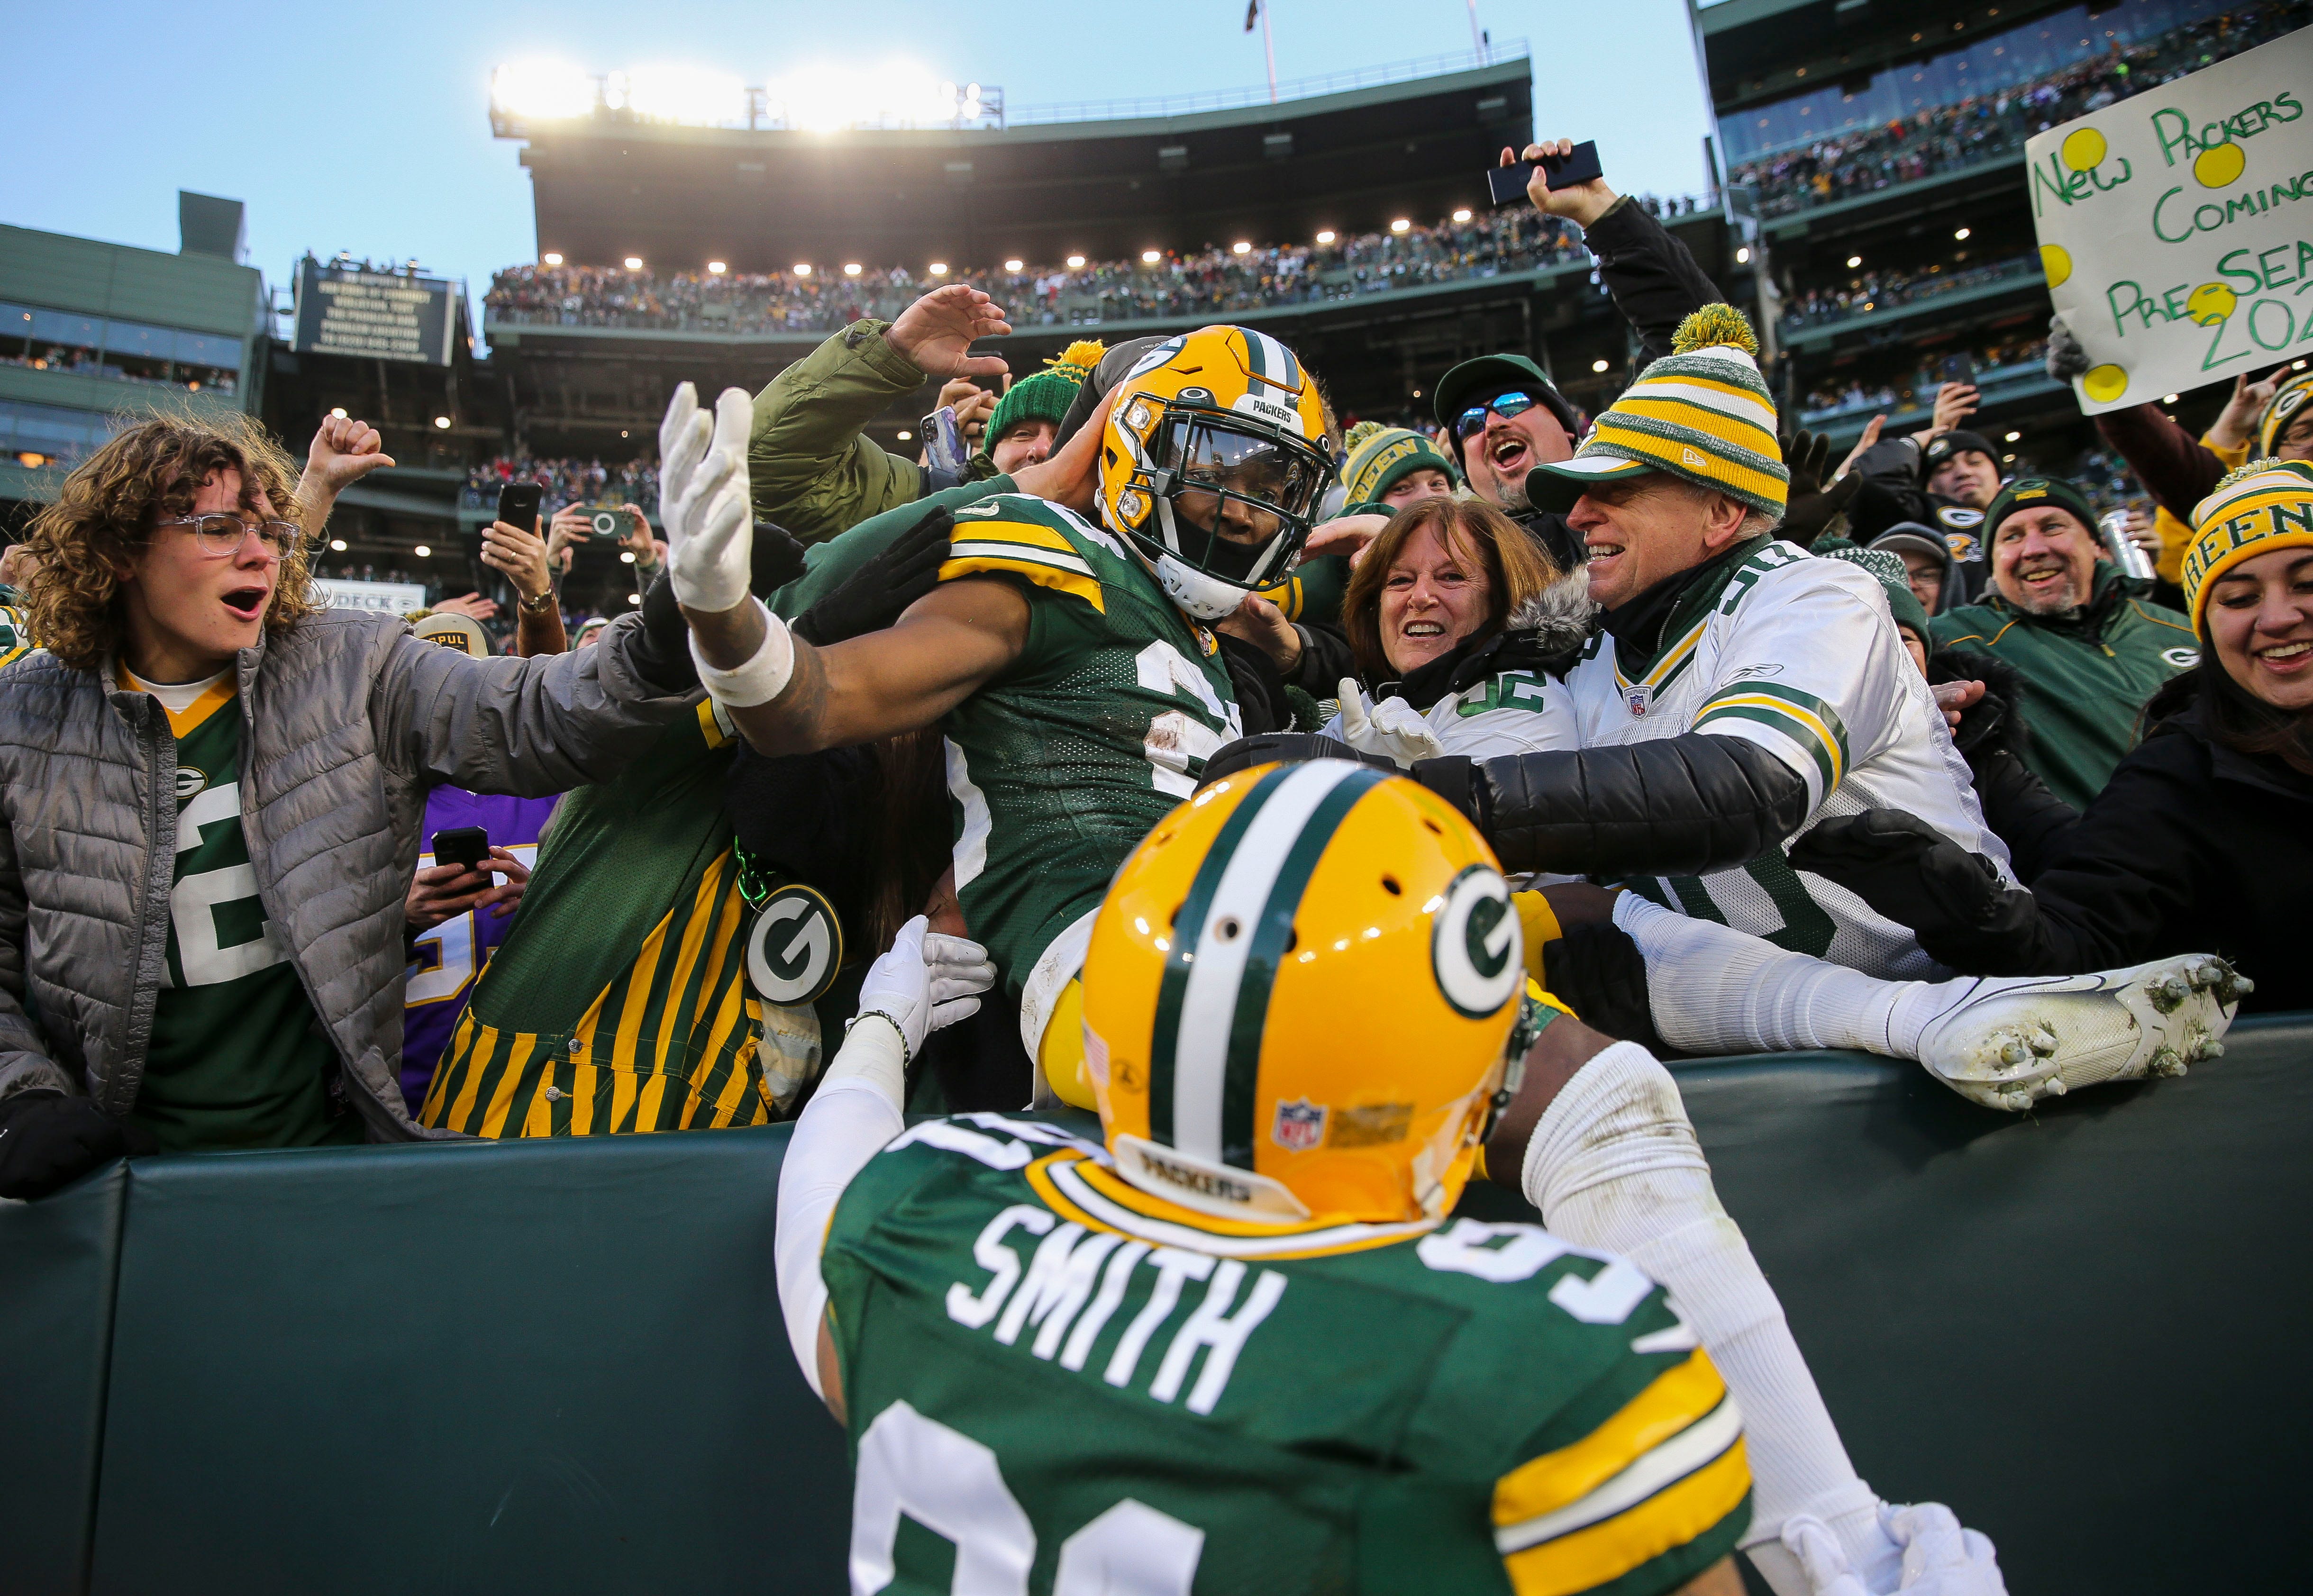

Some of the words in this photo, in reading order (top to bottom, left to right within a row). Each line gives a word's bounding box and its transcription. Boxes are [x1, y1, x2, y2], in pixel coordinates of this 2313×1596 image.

[2034, 153, 2132, 217] New
[1252, 399, 1292, 424] PACKERS
[1625, 689, 1648, 697] EQUIPMENT
[1632, 704, 1645, 715] NFL
[747, 897, 830, 1002] G
[1434, 868, 1523, 1012] G
[1139, 1152, 1251, 1203] PACKERS
[946, 1203, 1288, 1416] SMITH
